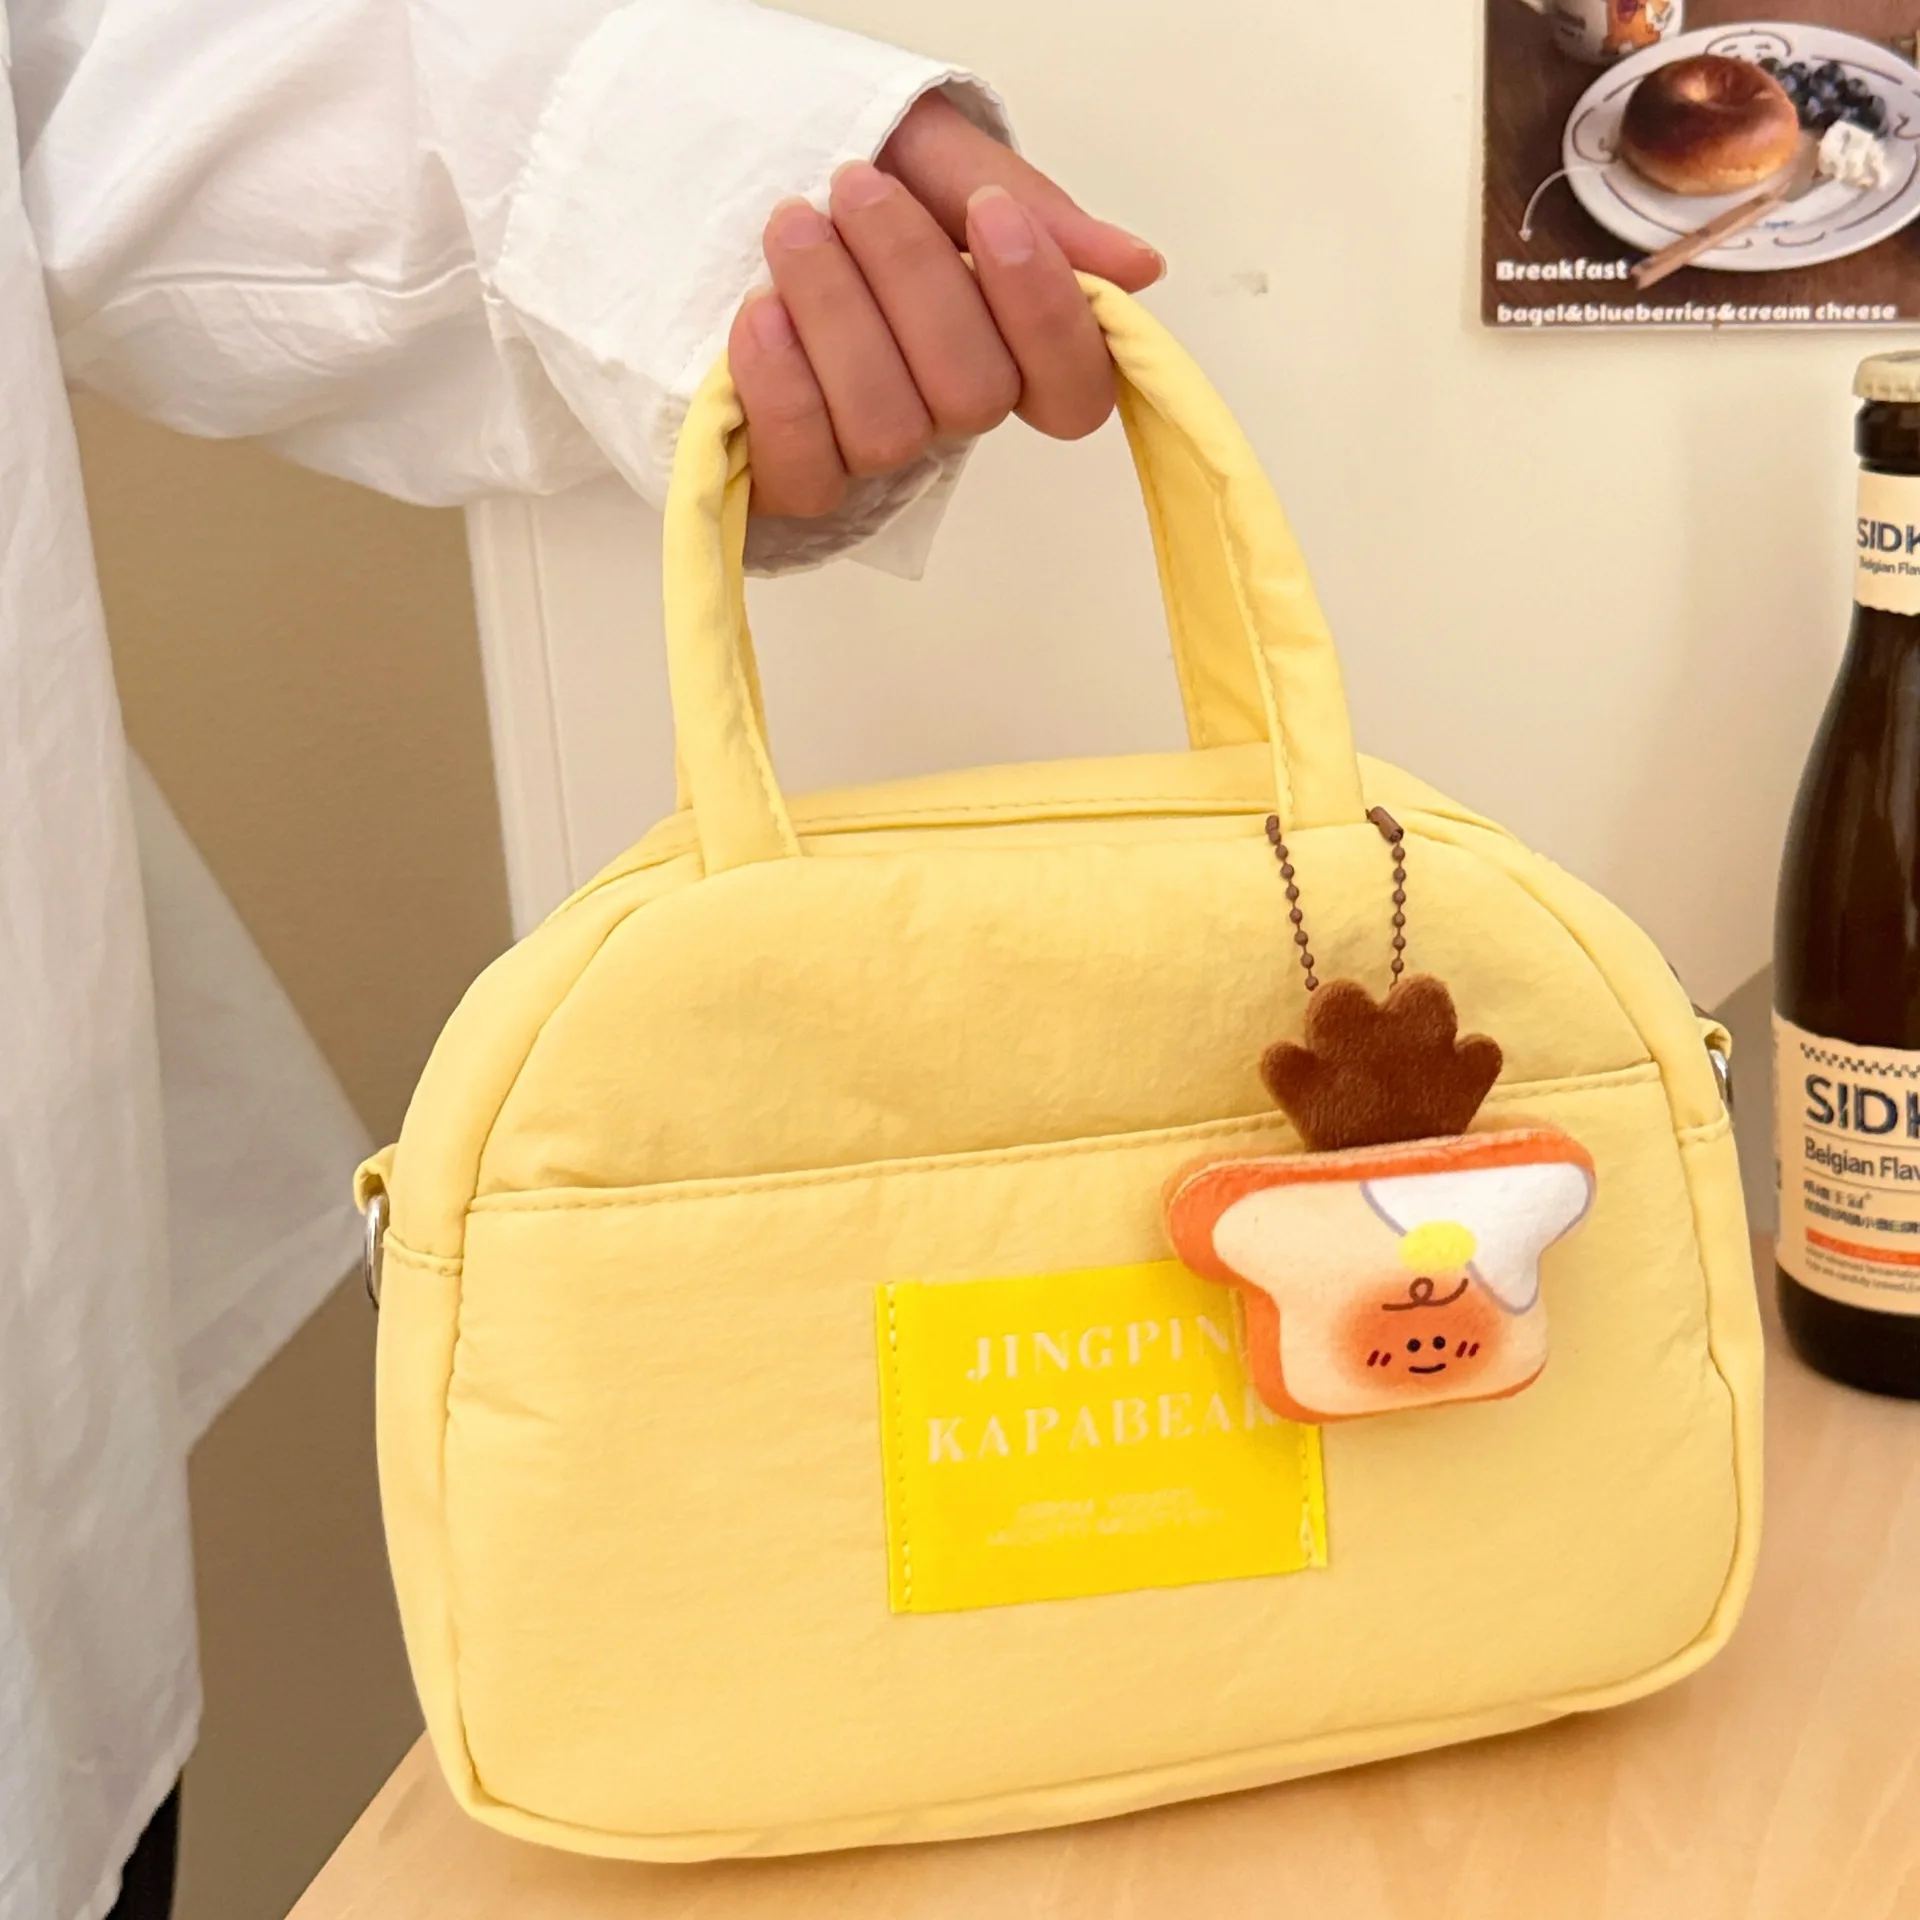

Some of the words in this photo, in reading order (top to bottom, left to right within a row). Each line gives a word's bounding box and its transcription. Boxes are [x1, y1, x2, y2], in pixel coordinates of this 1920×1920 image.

[1496, 257, 1629, 280] Breakfast
[1497, 302, 1809, 325] bagel&blueberries&cream
[1815, 302, 1897, 321] cheese
[1805, 1136, 1875, 1175] Belgian
[966, 1314, 1231, 1383] JINGPIN
